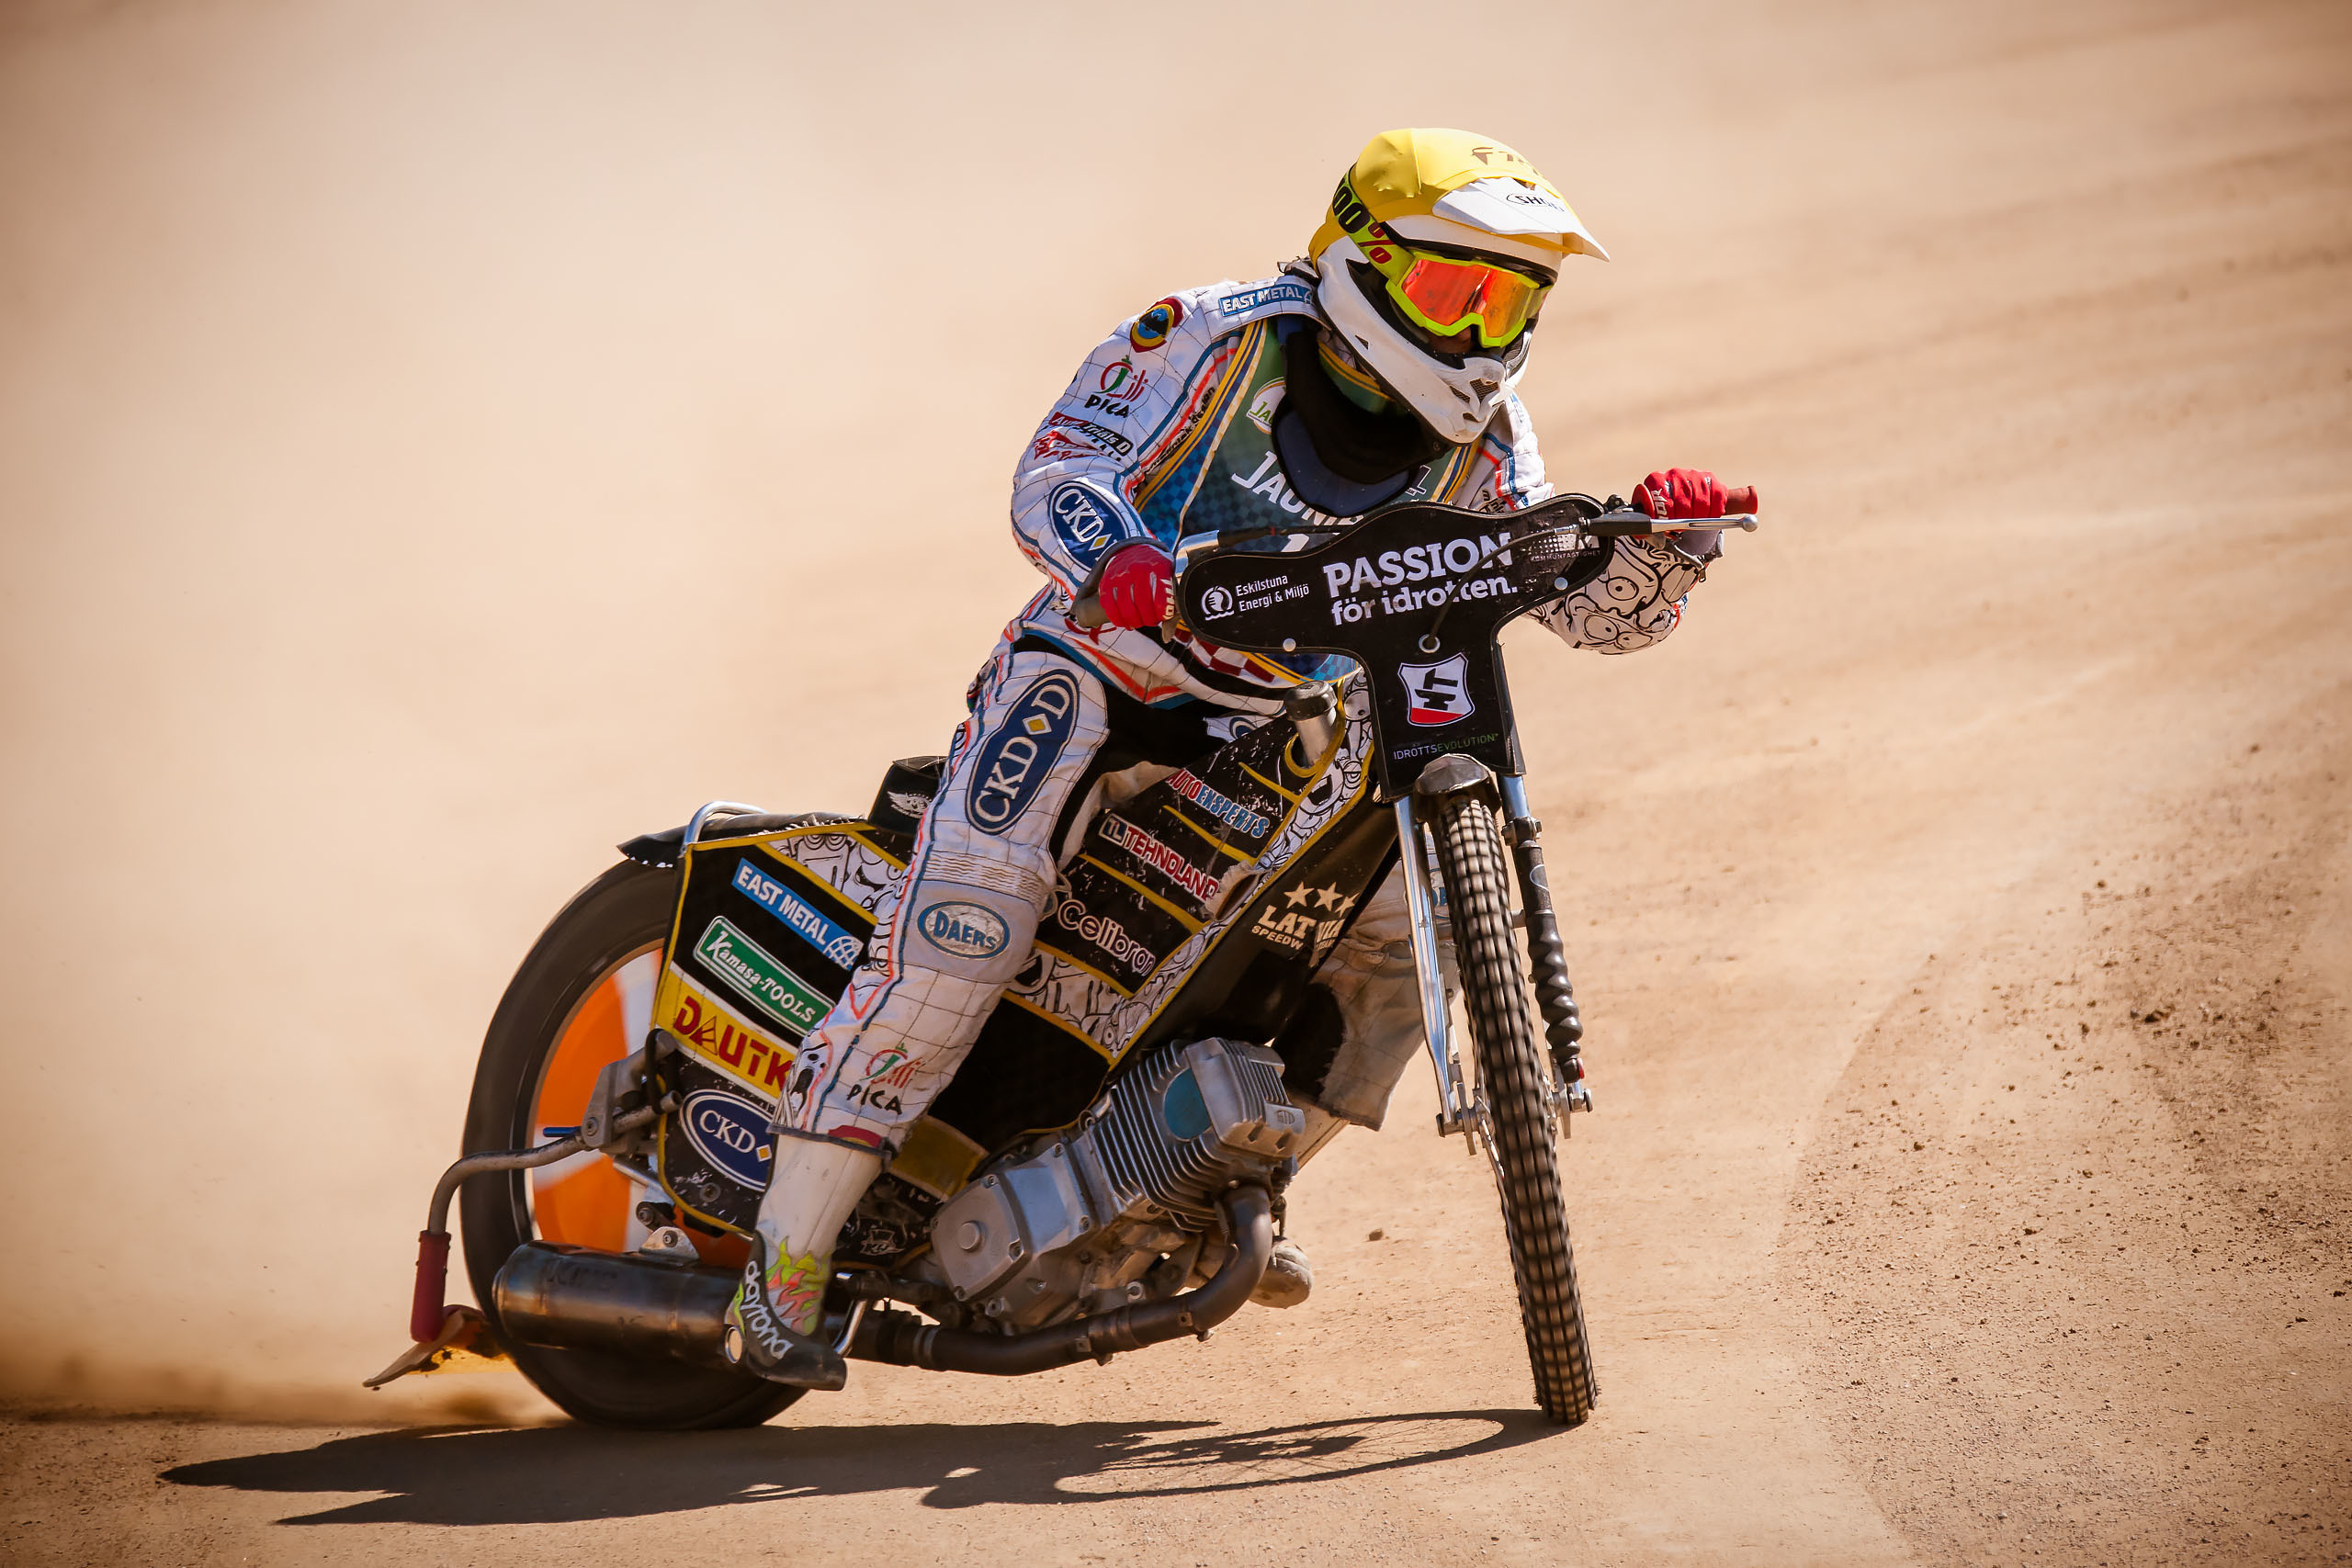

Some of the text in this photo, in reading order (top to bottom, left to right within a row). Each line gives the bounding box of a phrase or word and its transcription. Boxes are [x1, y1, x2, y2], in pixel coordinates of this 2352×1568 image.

[1222, 286, 1303, 312] EAST METAL
[1084, 394, 1129, 418] PICA
[1055, 489, 1104, 543] CKD
[1323, 532, 1513, 598] PASSION
[1236, 575, 1288, 596] Eskilstuna
[1238, 583, 1310, 612] Energi & Miljö
[1331, 596, 1375, 626] för
[975, 736, 1038, 823] CKD
[737, 865, 829, 946] EAST METAL
[933, 910, 997, 950] DAERS
[706, 930, 817, 1023] Kamasa-TOOLS
[846, 1084, 902, 1115] PICA
[699, 1110, 756, 1154] CKD
